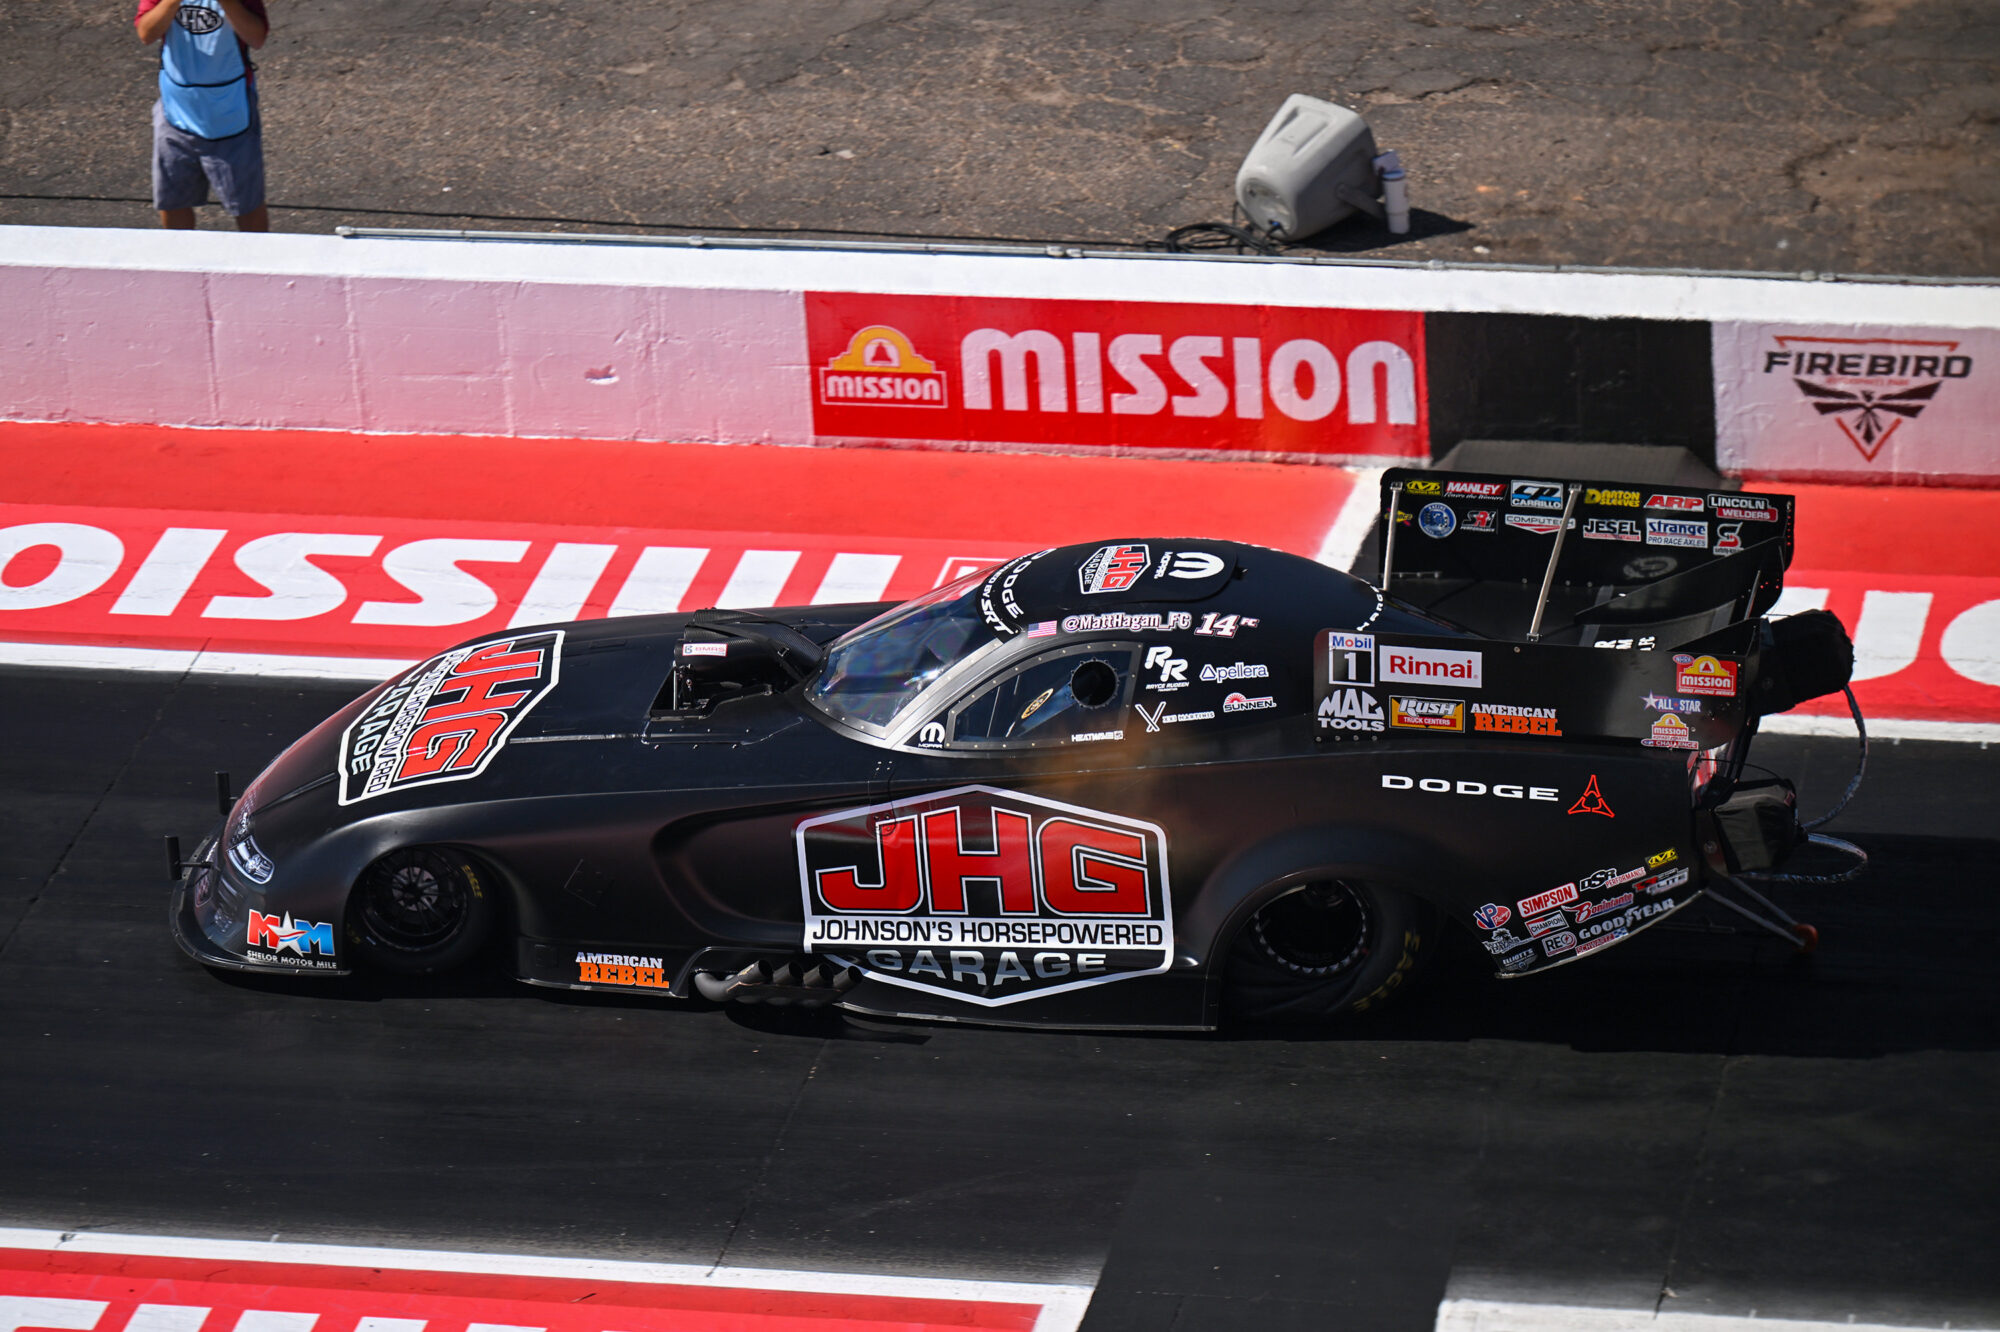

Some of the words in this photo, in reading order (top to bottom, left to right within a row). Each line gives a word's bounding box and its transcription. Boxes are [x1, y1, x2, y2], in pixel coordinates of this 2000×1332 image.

[1764, 350, 1973, 379] FIREBIRD
[961, 327, 1418, 425] MISSION
[826, 375, 941, 400] MISSION
[1446, 481, 1500, 494] MANLEY
[1584, 488, 1640, 504] DARTON
[1512, 498, 1562, 509] CARRILLO
[1600, 499, 1640, 508] SLEEVES
[1645, 494, 1703, 511] ARP
[1710, 496, 1765, 510] LINCOLN
[1722, 508, 1771, 520] WELDERS
[1584, 519, 1640, 535] JESEL
[1648, 536, 1662, 544] PRO
[1663, 537, 1682, 546] RACE
[1683, 538, 1706, 547] AXLES
[1084, 553, 1104, 585] GARAGE
[1101, 546, 1145, 589] JHG
[1003, 547, 1057, 619] DODGE
[981, 598, 1015, 635] SRT
[1063, 611, 1192, 632] @MattHagan_FC
[1194, 611, 1240, 639] 14
[1240, 616, 1260, 628] FC
[1331, 635, 1373, 649] Mobil
[1344, 652, 1357, 681] 1
[1389, 654, 1473, 680] Rinnai
[1681, 675, 1731, 688] MISSION
[394, 641, 546, 782] JHG
[1224, 699, 1274, 712] SUNNEN
[1317, 688, 1385, 720] MAC
[1399, 697, 1457, 717] RUSH
[1470, 702, 1557, 719] AMERICAN
[1658, 698, 1674, 711] ALL
[1679, 699, 1701, 713] STAR
[1317, 717, 1385, 732] TOOLS
[1403, 716, 1423, 725] TRUCK
[1424, 717, 1450, 726] CENTERS
[1474, 712, 1563, 737] REBEL
[1653, 727, 1687, 735] MISSION
[1381, 774, 1559, 801] DODGE
[813, 806, 1152, 919] JHG
[1605, 867, 1646, 888] PERFORMANCE
[1521, 885, 1574, 915] SIMPSON
[1473, 903, 1498, 929] VP
[1530, 916, 1563, 933] CHAMPION
[1579, 898, 1675, 940] GOODYEAR
[812, 919, 953, 942] JOHNSON'S
[961, 921, 1163, 946] HORSEPOWERED
[246, 949, 278, 963] SHELOR
[280, 956, 313, 967] MOTOR
[316, 960, 337, 969] MILE
[575, 951, 663, 969] AMERICAN
[866, 949, 1107, 987] GARAGE
[579, 961, 670, 989] REBEL
